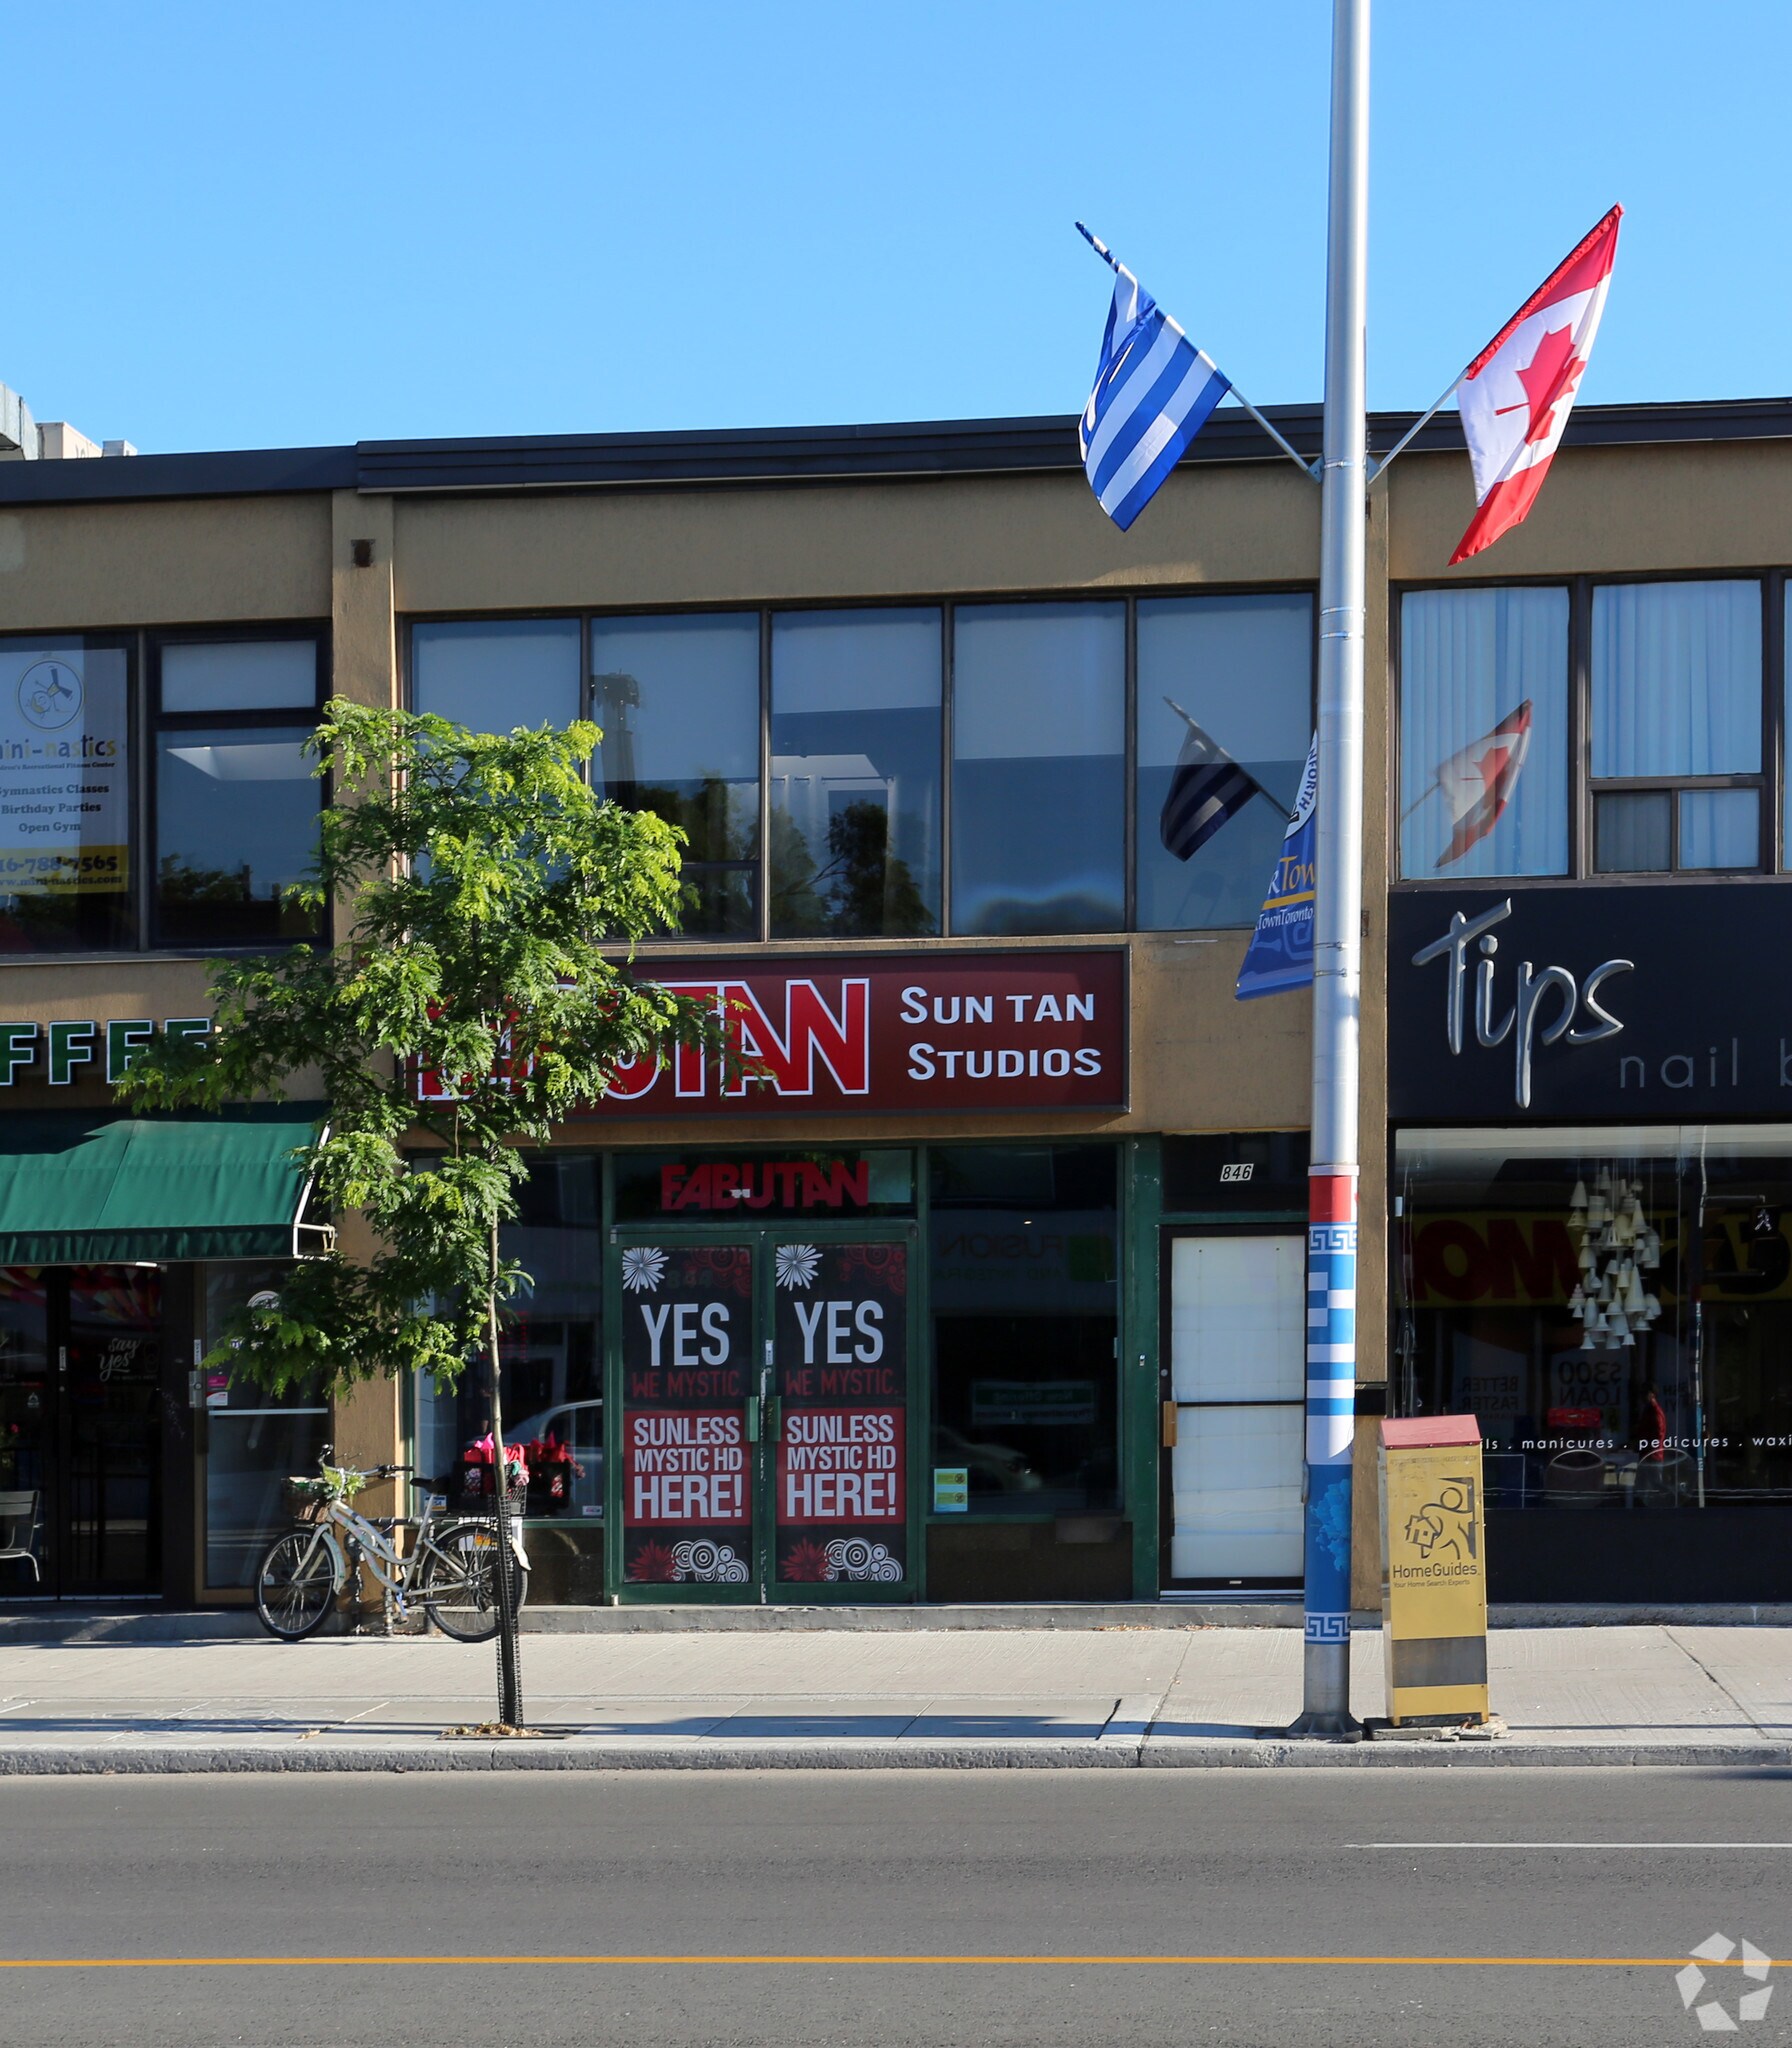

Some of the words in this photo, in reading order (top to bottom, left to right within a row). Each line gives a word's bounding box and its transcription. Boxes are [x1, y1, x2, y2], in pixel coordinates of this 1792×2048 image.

[66, 784, 110, 794] Classes
[1, 804, 55, 815] Birthday
[58, 802, 102, 812] Parties
[18, 823, 50, 834] Open
[53, 822, 82, 832] Gym
[1006, 994, 1094, 1023] TAN
[1411, 897, 1634, 1109] Tips
[1620, 1037, 1738, 1088] nail
[661, 1160, 869, 1210] FABUTAN
[1222, 1165, 1252, 1180] 846
[641, 1303, 730, 1366] YES
[794, 1300, 884, 1364] YES
[108, 1338, 141, 1359] say
[632, 1371, 660, 1398] WE
[786, 1369, 814, 1396] WE
[821, 1368, 899, 1395] MYSTIC.
[634, 1416, 740, 1446] SUNLESS
[786, 1414, 894, 1444] SUNLESS
[1522, 1437, 1613, 1449] manicures
[1639, 1435, 1729, 1450] pedicures
[634, 1447, 709, 1472] MYSTIC
[714, 1447, 743, 1472] HD
[787, 1446, 862, 1470] MYSTIC
[866, 1446, 896, 1470] HD
[634, 1474, 743, 1519] HERE!
[786, 1472, 896, 1517] HERE!
[1393, 1562, 1477, 1578] HomeGuides
